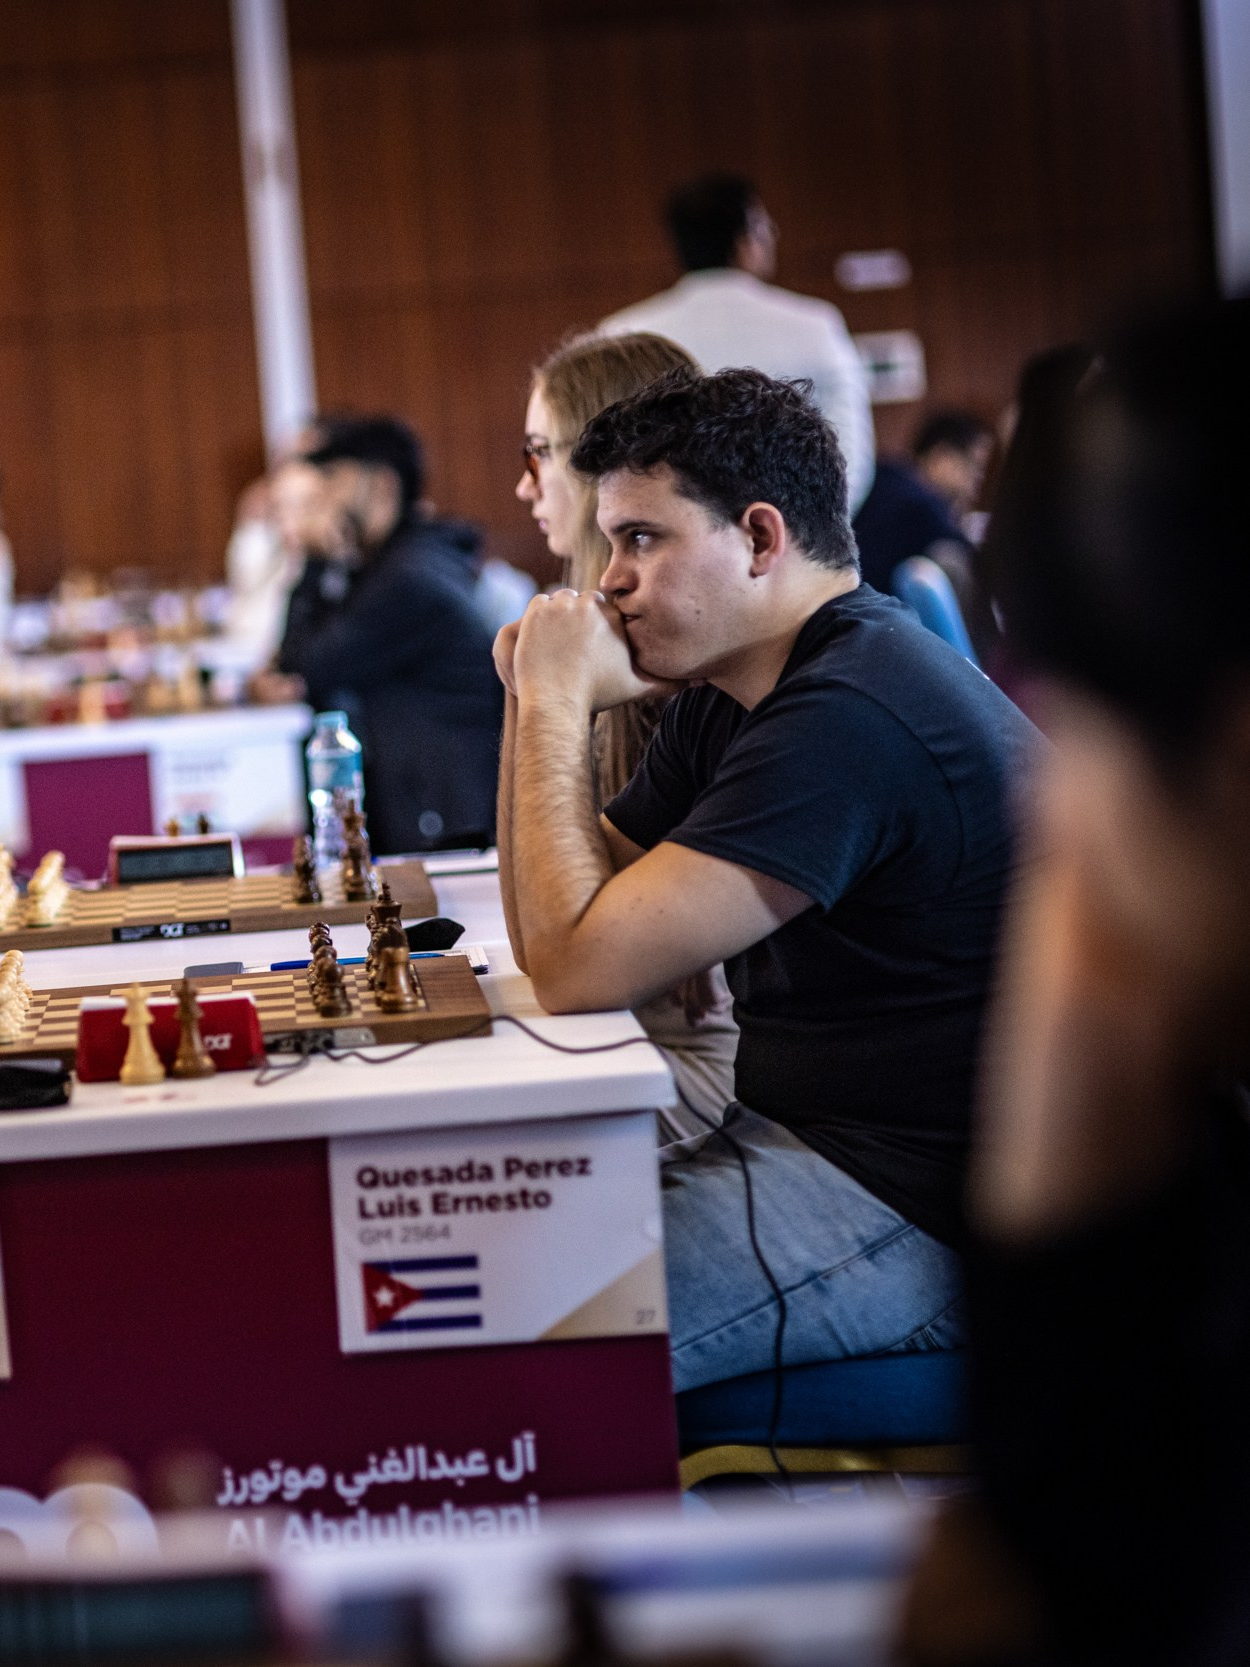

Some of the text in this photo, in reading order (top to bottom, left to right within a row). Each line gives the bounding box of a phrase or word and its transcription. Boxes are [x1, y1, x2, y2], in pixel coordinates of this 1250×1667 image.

[356, 1156, 593, 1190] Quesada Perez
[357, 1187, 553, 1220] Luis Ernesto
[359, 1224, 451, 1246] GM 2564
[216, 1431, 537, 1506] آل عبدالغني موتورز
[226, 1495, 540, 1550] Al Abdulghani
